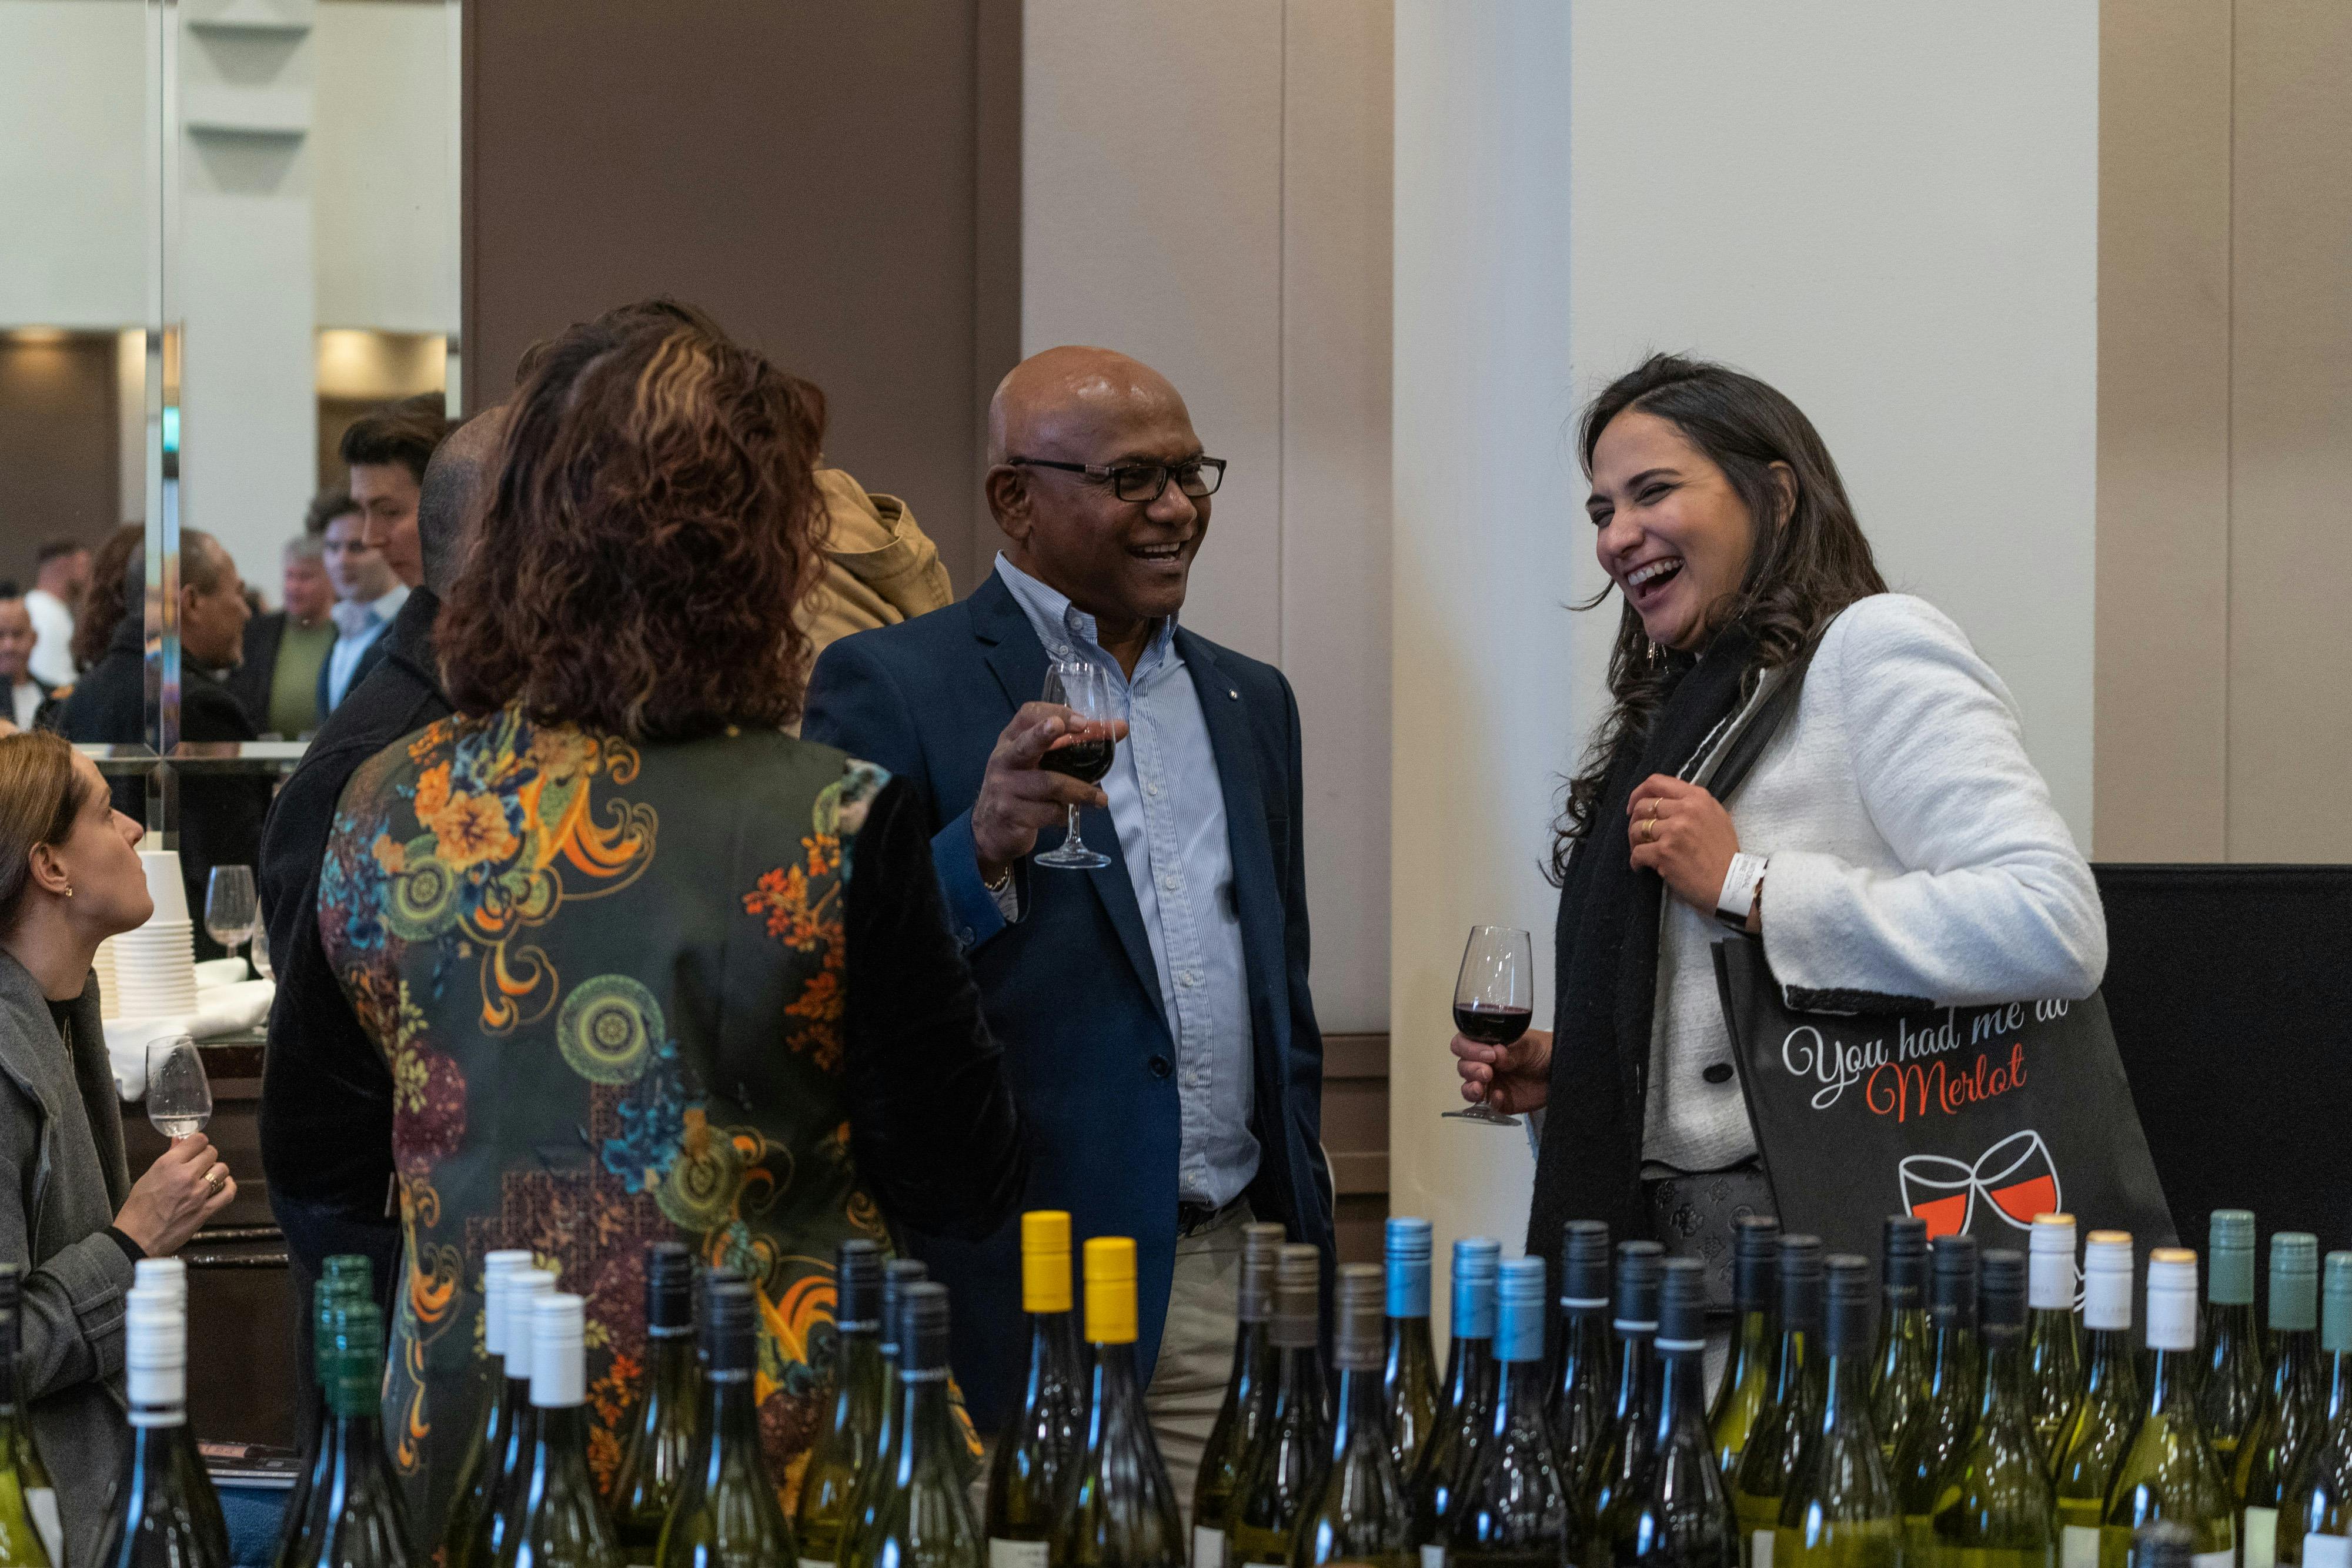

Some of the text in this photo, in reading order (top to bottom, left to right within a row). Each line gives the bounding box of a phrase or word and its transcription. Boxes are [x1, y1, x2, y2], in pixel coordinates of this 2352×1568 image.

[1782, 1025, 1888, 1109] You
[1899, 1006, 1960, 1062] had
[1971, 1001, 2024, 1045] me
[1866, 1042, 2027, 1122] Merlot
